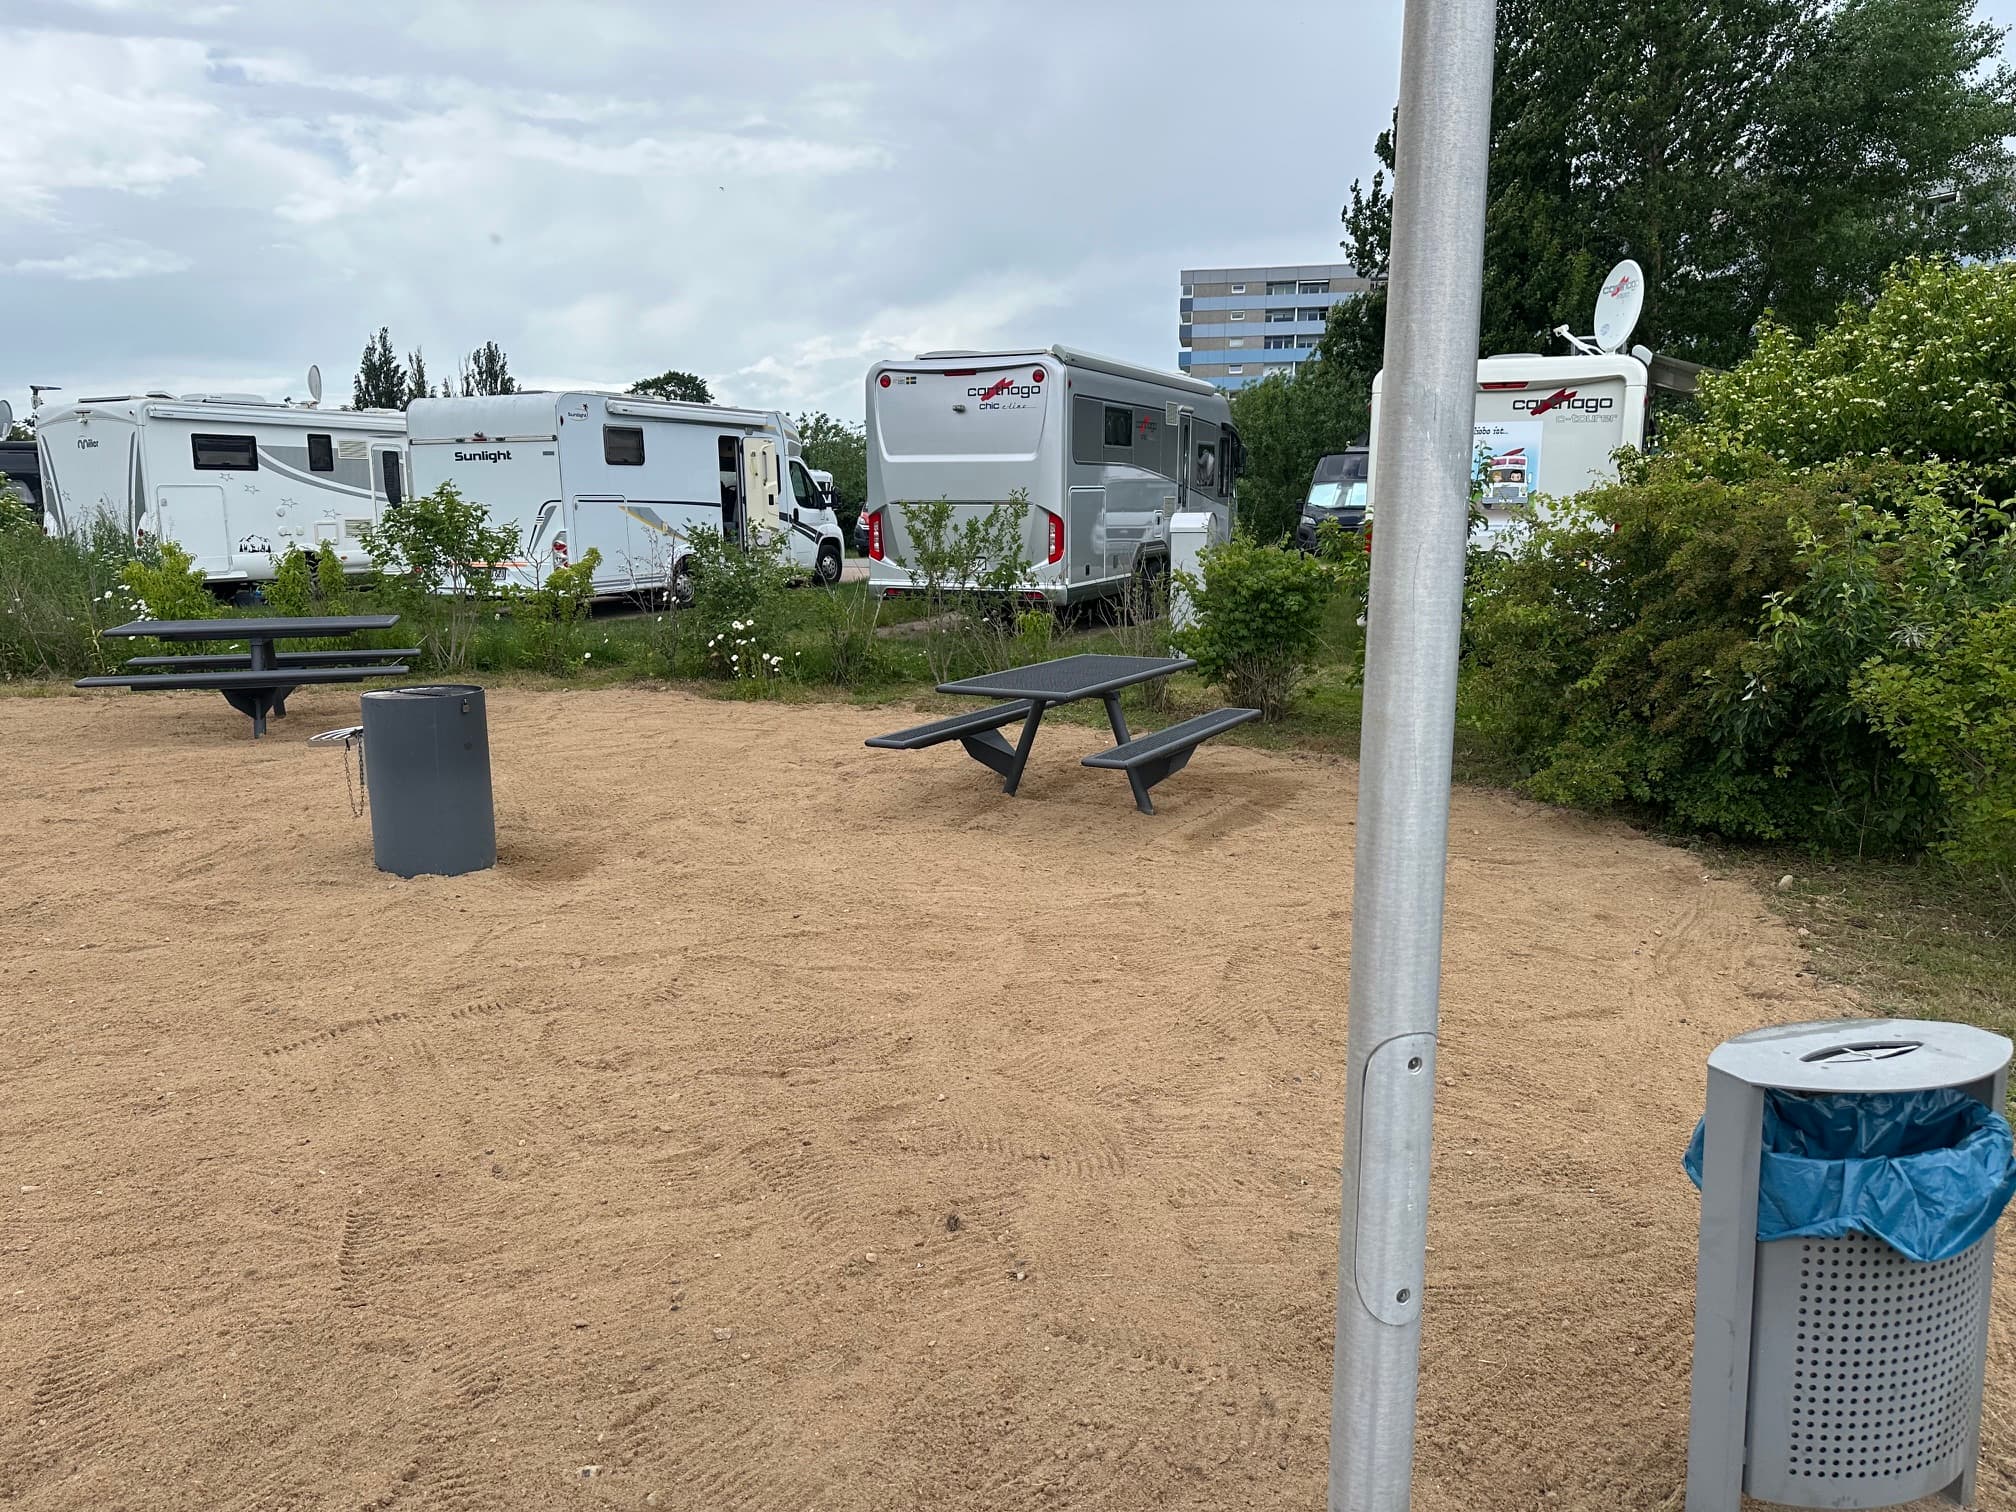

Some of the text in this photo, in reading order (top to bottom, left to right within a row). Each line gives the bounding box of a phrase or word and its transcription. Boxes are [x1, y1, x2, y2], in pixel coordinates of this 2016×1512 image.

[966, 385, 1041, 399] carthago
[979, 402, 1000, 410] chic
[1512, 397, 1614, 413] carthago
[454, 450, 512, 464] Sunlight
